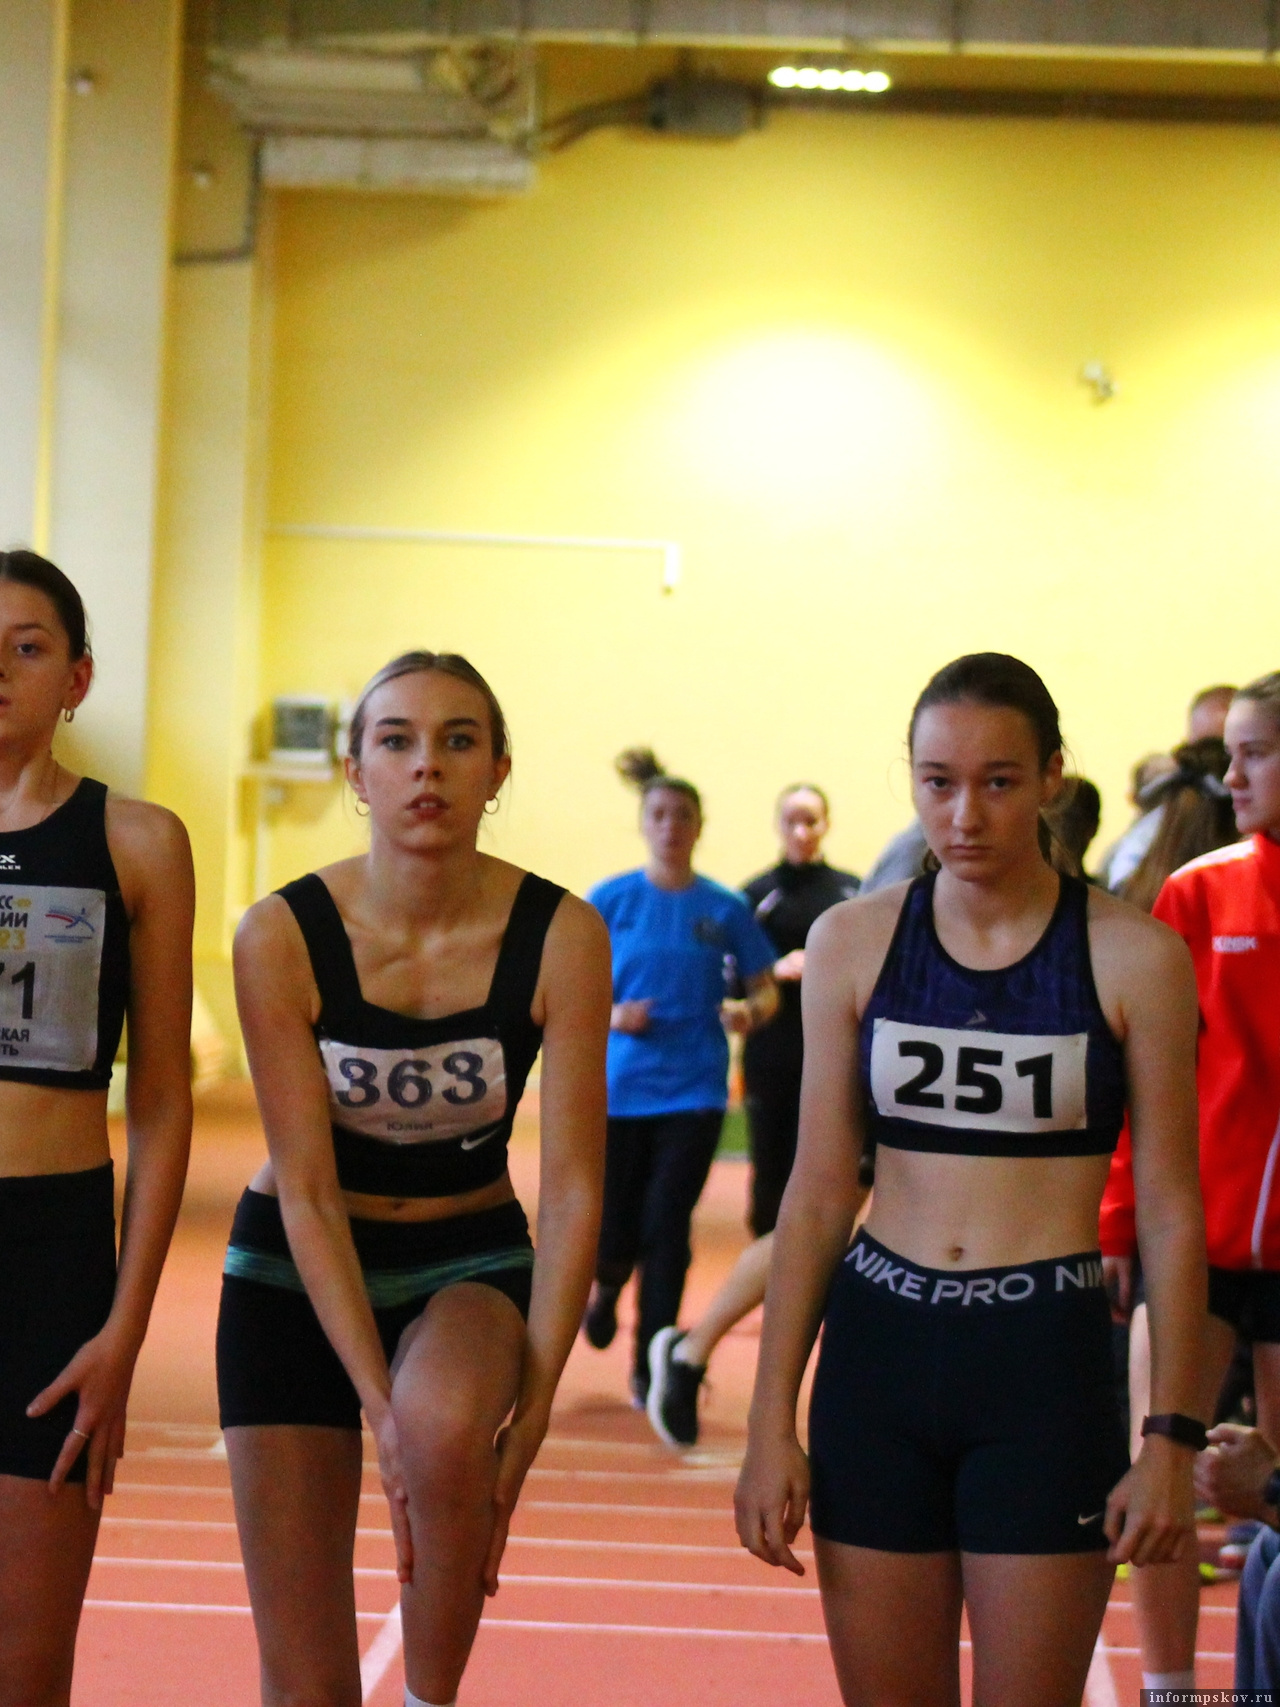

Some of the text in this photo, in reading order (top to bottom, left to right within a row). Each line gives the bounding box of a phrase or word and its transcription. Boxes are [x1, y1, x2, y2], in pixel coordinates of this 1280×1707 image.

[335, 1051, 488, 1108] 363
[894, 1040, 1053, 1119] 251
[844, 1242, 927, 1301] NIKE
[930, 1272, 1035, 1306] PRO
